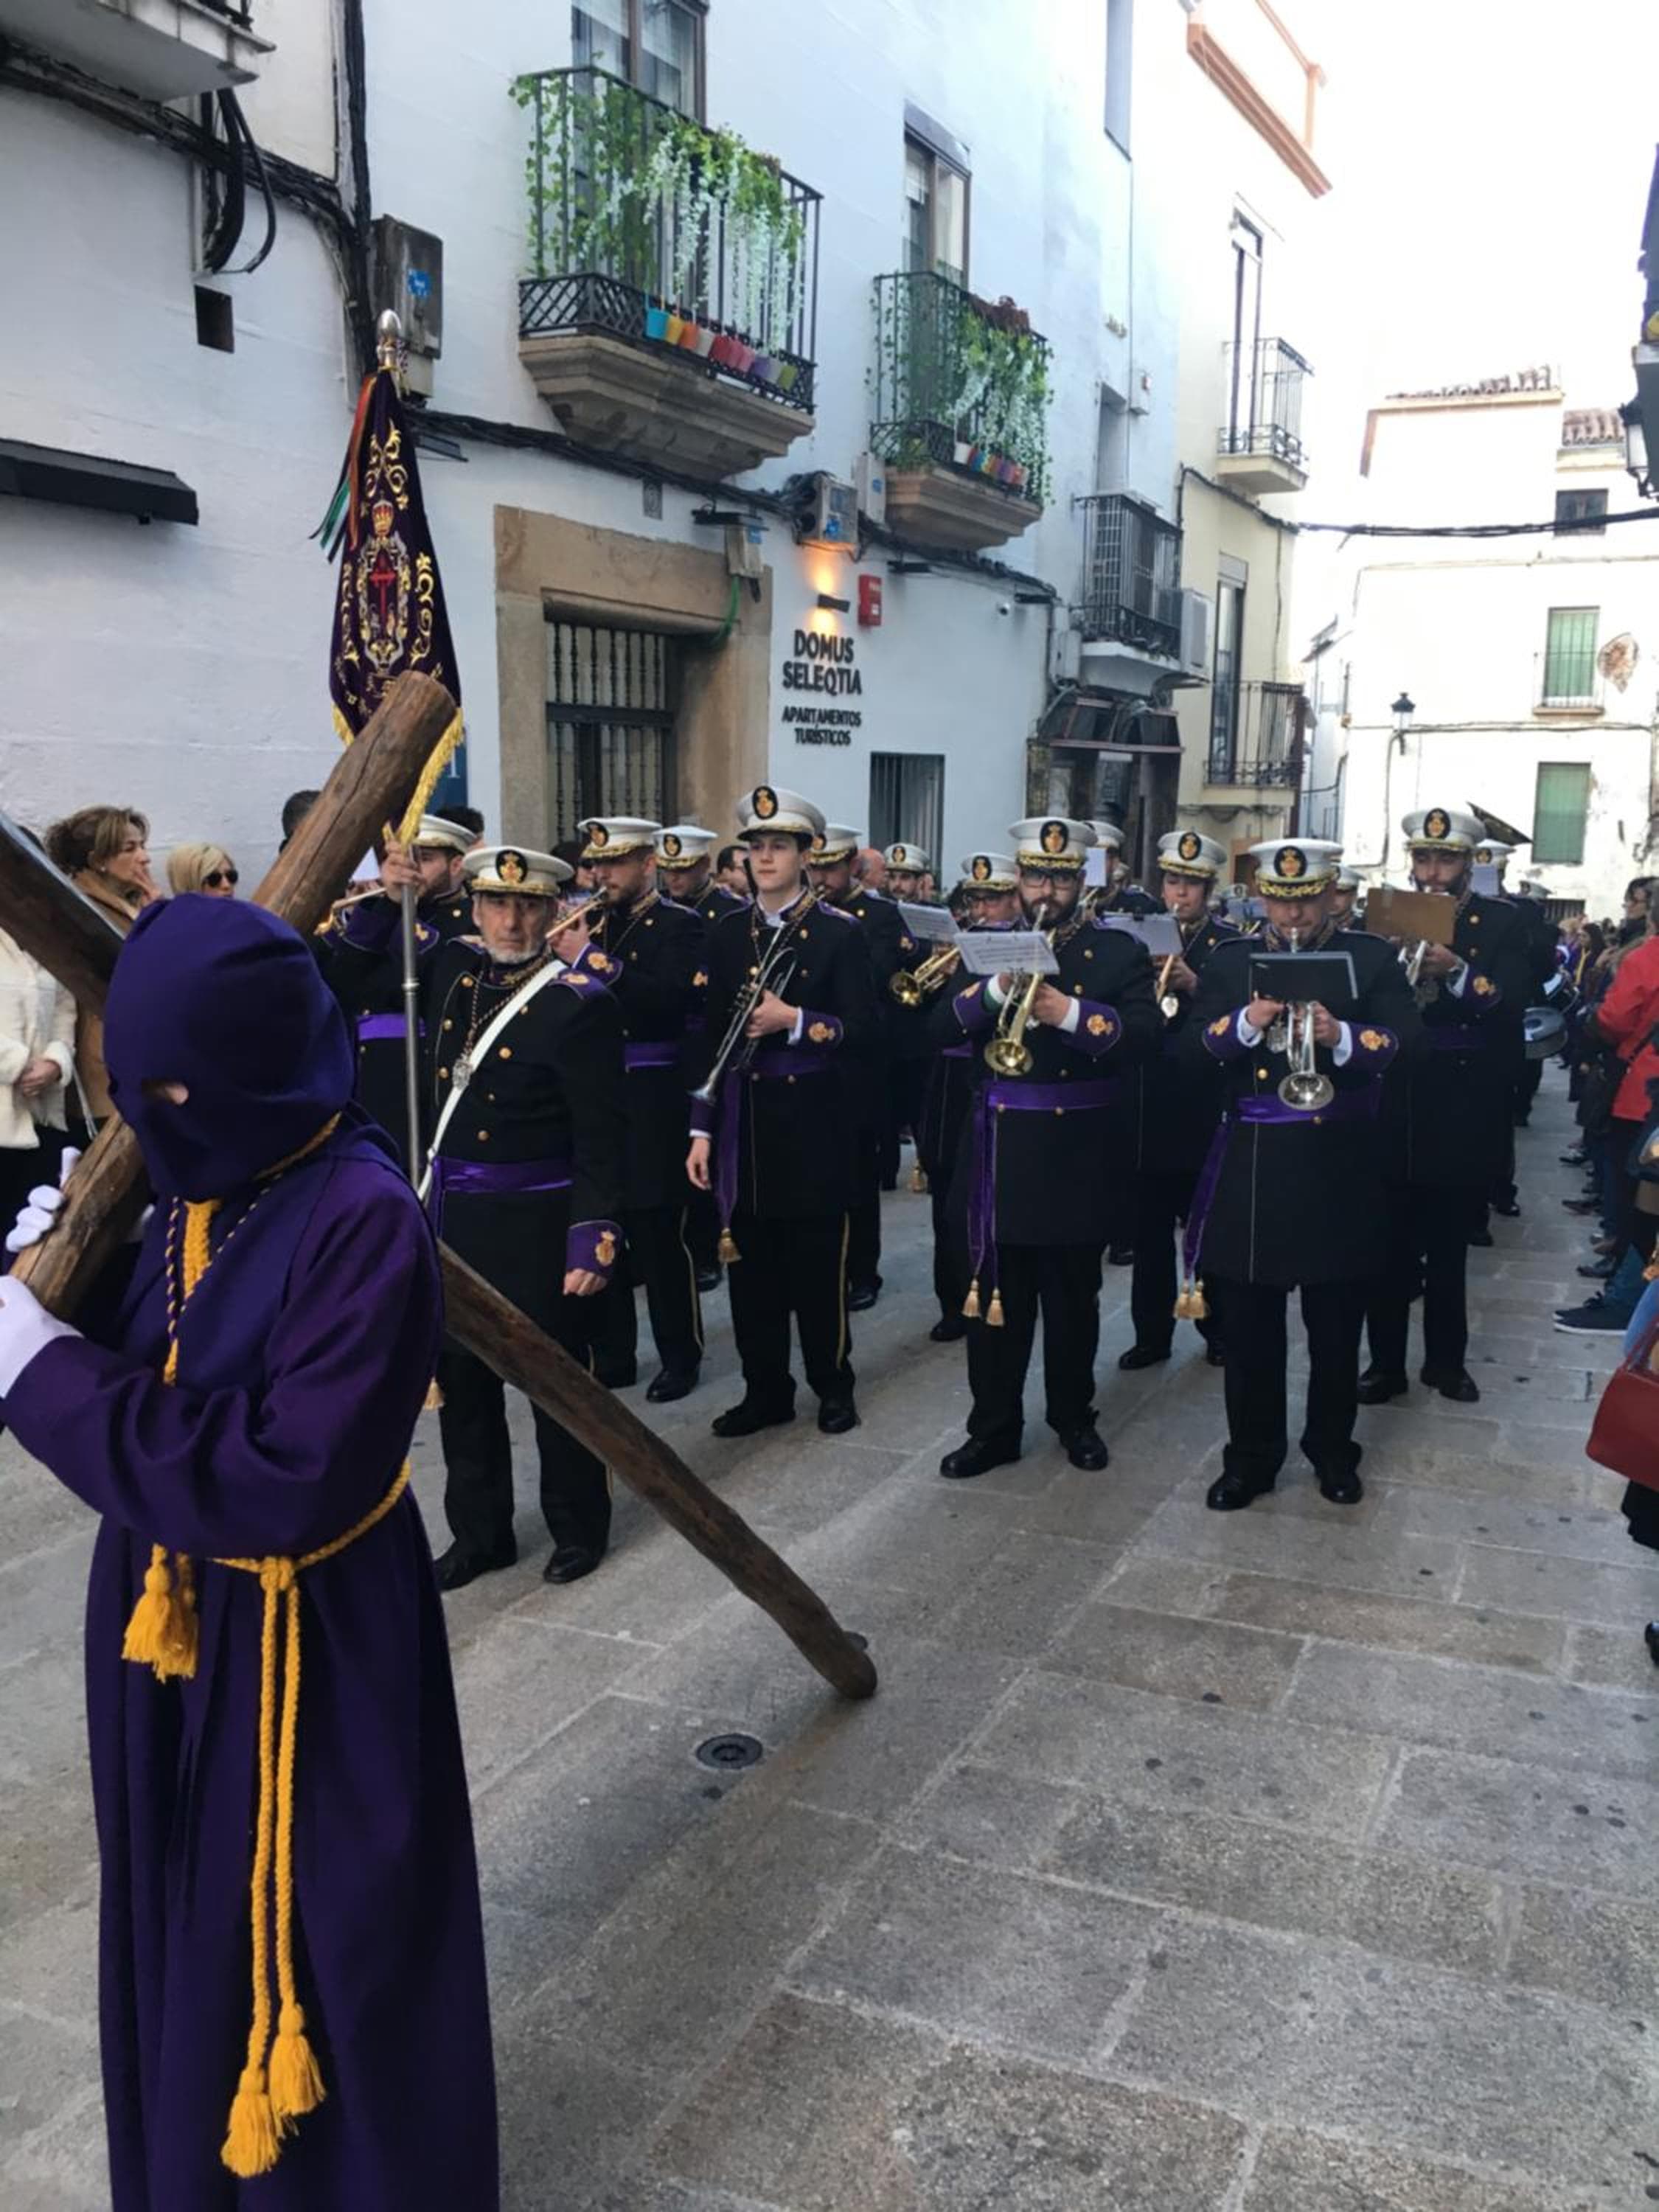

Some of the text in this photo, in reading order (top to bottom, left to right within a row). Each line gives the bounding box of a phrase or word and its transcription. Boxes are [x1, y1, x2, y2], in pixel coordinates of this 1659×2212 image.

[794, 630, 854, 663] DOMUS
[782, 661, 862, 696] SELEQTIA
[782, 706, 862, 728] APARTAMENTOS
[794, 723, 852, 746] TURÍSTICOS
